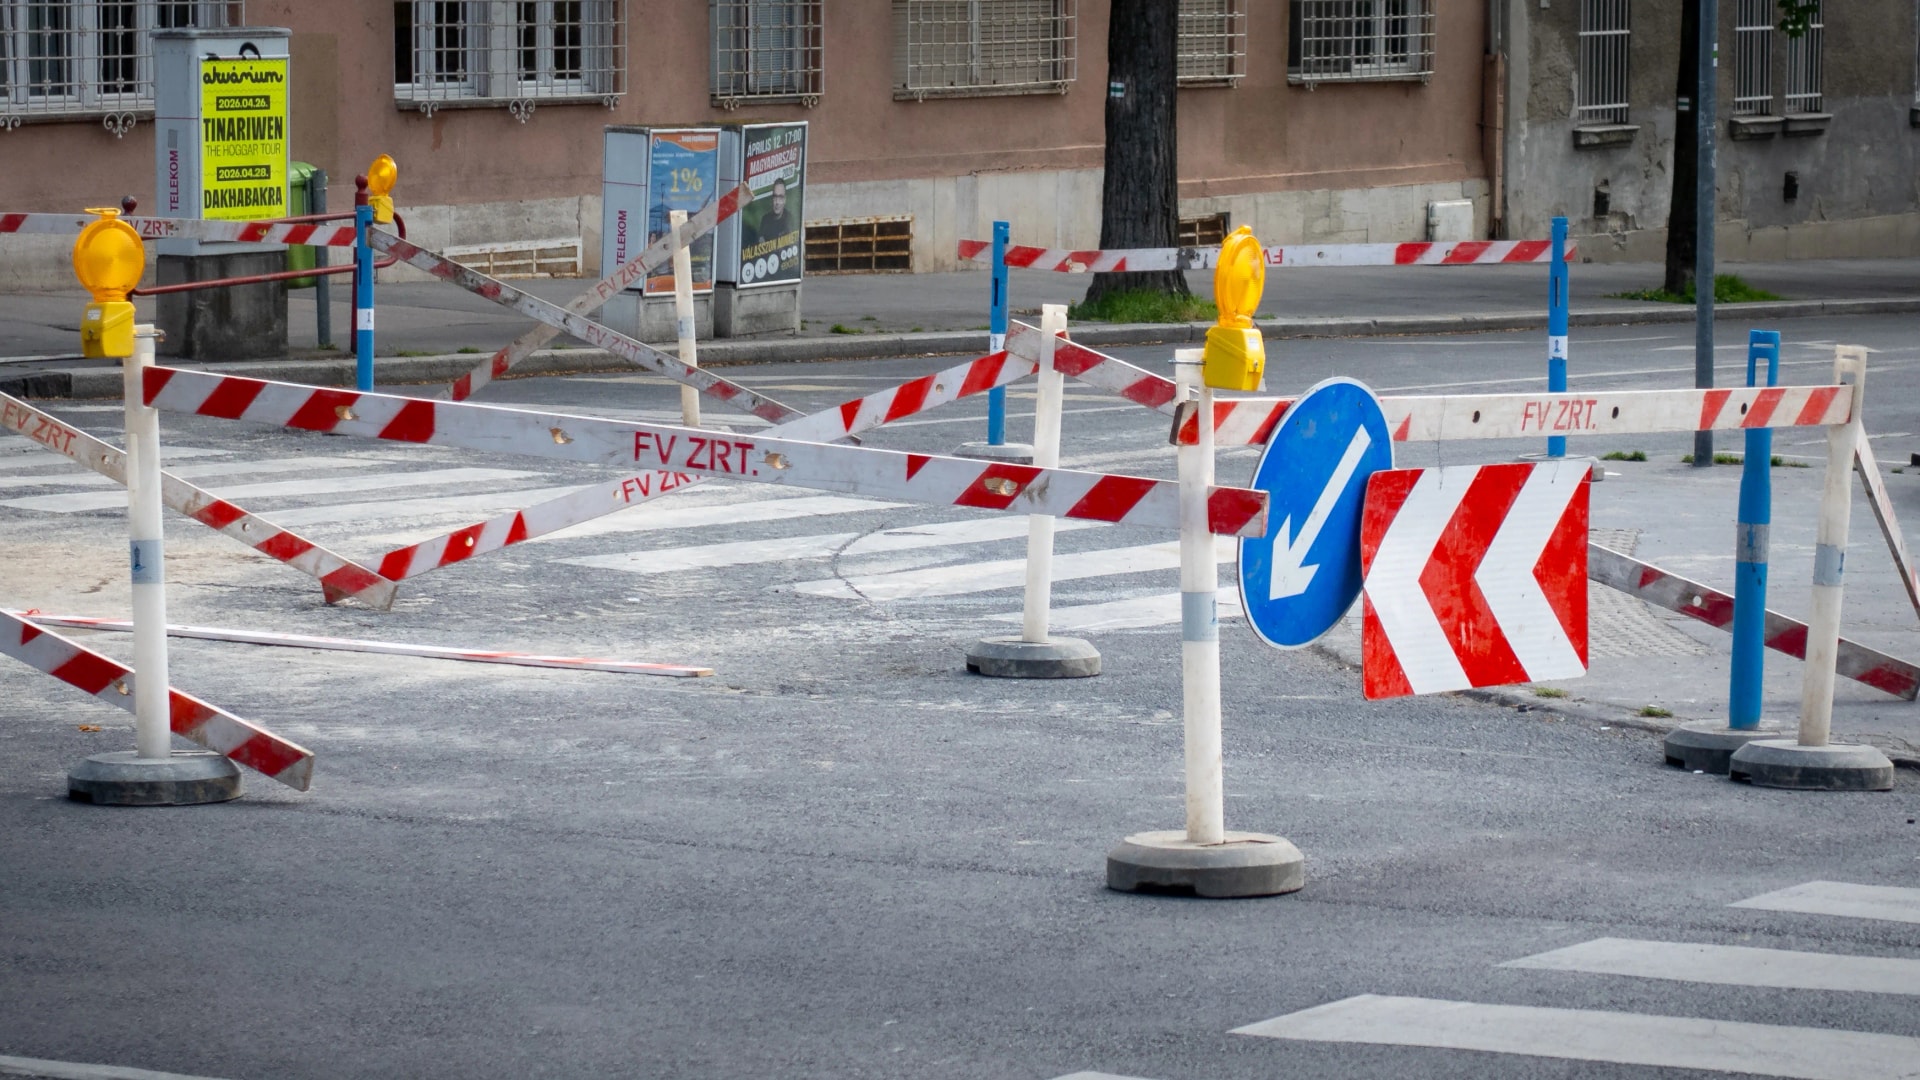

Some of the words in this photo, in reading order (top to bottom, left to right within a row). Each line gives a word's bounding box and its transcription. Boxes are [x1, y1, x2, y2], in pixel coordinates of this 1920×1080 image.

[218, 97, 268, 109] 2026.04.26.
[203, 116, 283, 142] TINARIWEN
[205, 144, 221, 157] THE
[223, 143, 259, 156] HOGGAR
[260, 143, 281, 155] TOUR
[747, 138, 771, 158] ÁPRILIS
[785, 128, 801, 146] 17:00
[218, 168, 269, 179] 2026.04.28.
[750, 146, 797, 175] MAGYARORSZÁG
[169, 150, 179, 212] TELEKOM
[670, 167, 703, 192] 1%
[204, 186, 282, 209] DAKHABAKRA
[616, 210, 627, 265] TELEKOM
[596, 276, 616, 300] FV
[585, 325, 607, 345] FV
[2, 401, 31, 430] FV
[32, 417, 77, 456] ZRT.
[1521, 401, 1551, 431] FV
[1553, 399, 1598, 431] ZRT.
[634, 431, 677, 465] FV
[686, 436, 758, 476] ZRT.
[622, 473, 650, 503] FV
